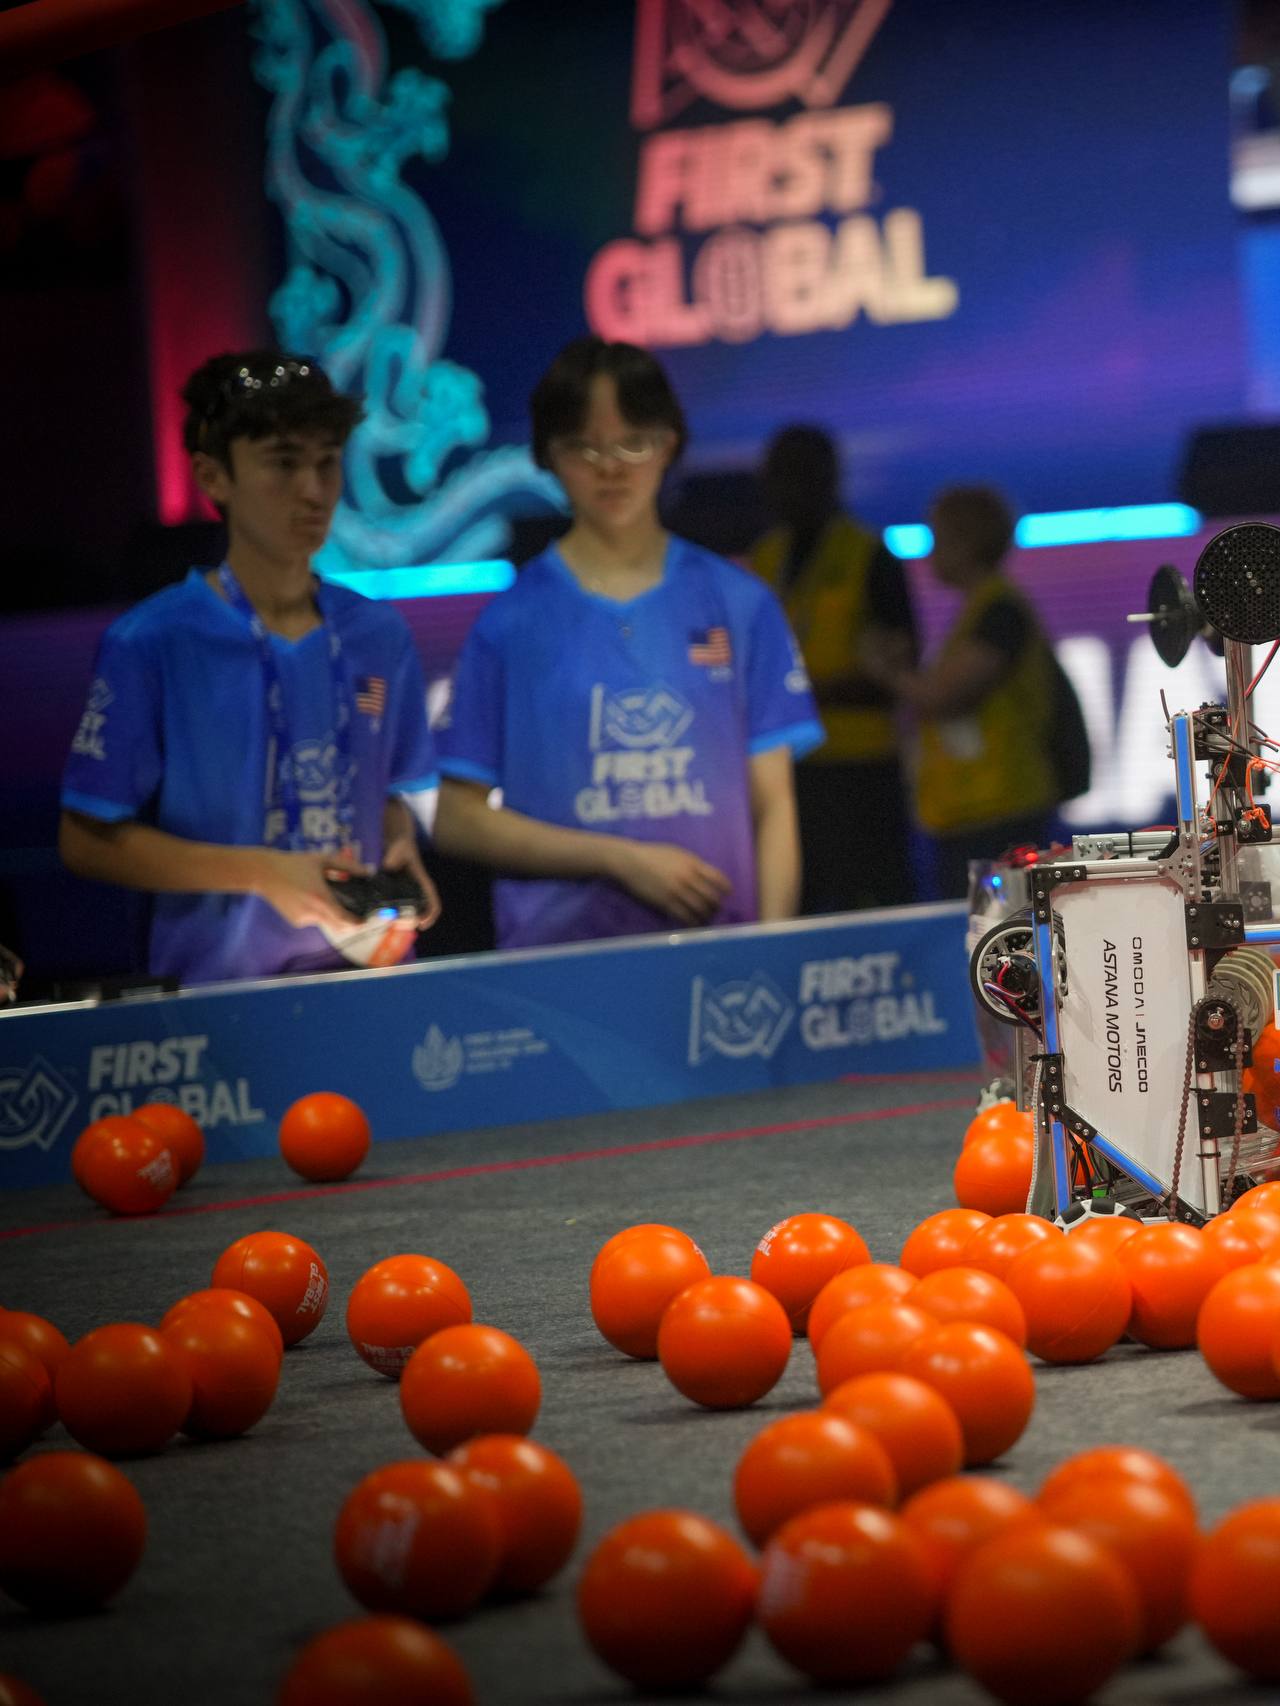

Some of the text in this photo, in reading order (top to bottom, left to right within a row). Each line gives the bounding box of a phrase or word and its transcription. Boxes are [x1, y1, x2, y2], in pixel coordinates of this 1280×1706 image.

[634, 102, 893, 236] FIRST
[584, 207, 958, 350] GLOBAL
[592, 746, 695, 785] FIRST
[574, 777, 713, 824] GLOBAL
[801, 952, 900, 1004] FIRST
[1133, 936, 1145, 1009] OMODA
[801, 991, 947, 1051] GLOBAL
[1103, 939, 1122, 1093] ASTANA MOTORS
[89, 1034, 208, 1092] FIRST
